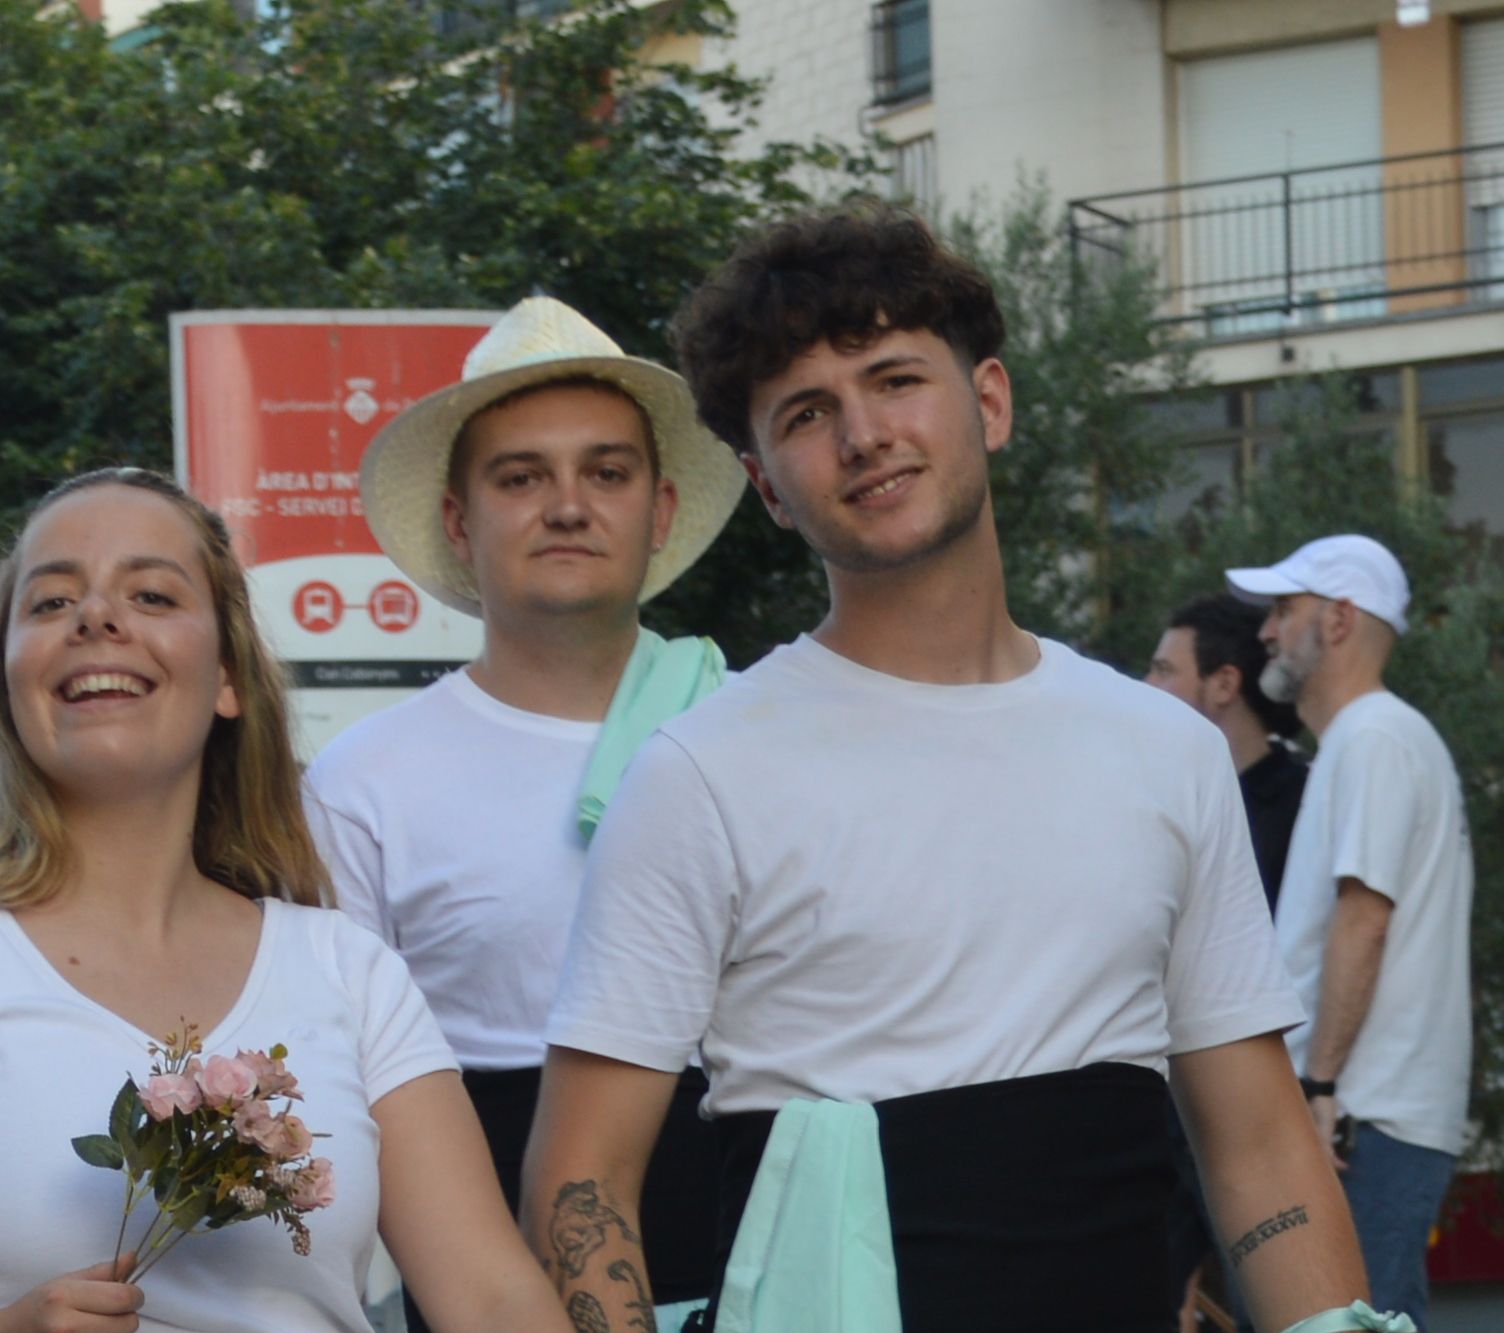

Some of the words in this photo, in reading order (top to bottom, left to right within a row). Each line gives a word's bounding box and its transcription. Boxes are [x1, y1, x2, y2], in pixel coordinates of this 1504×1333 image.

[260, 398, 339, 416] Ajuntament
[255, 467, 311, 490] ÀREA
[277, 497, 348, 517] SERVEI
